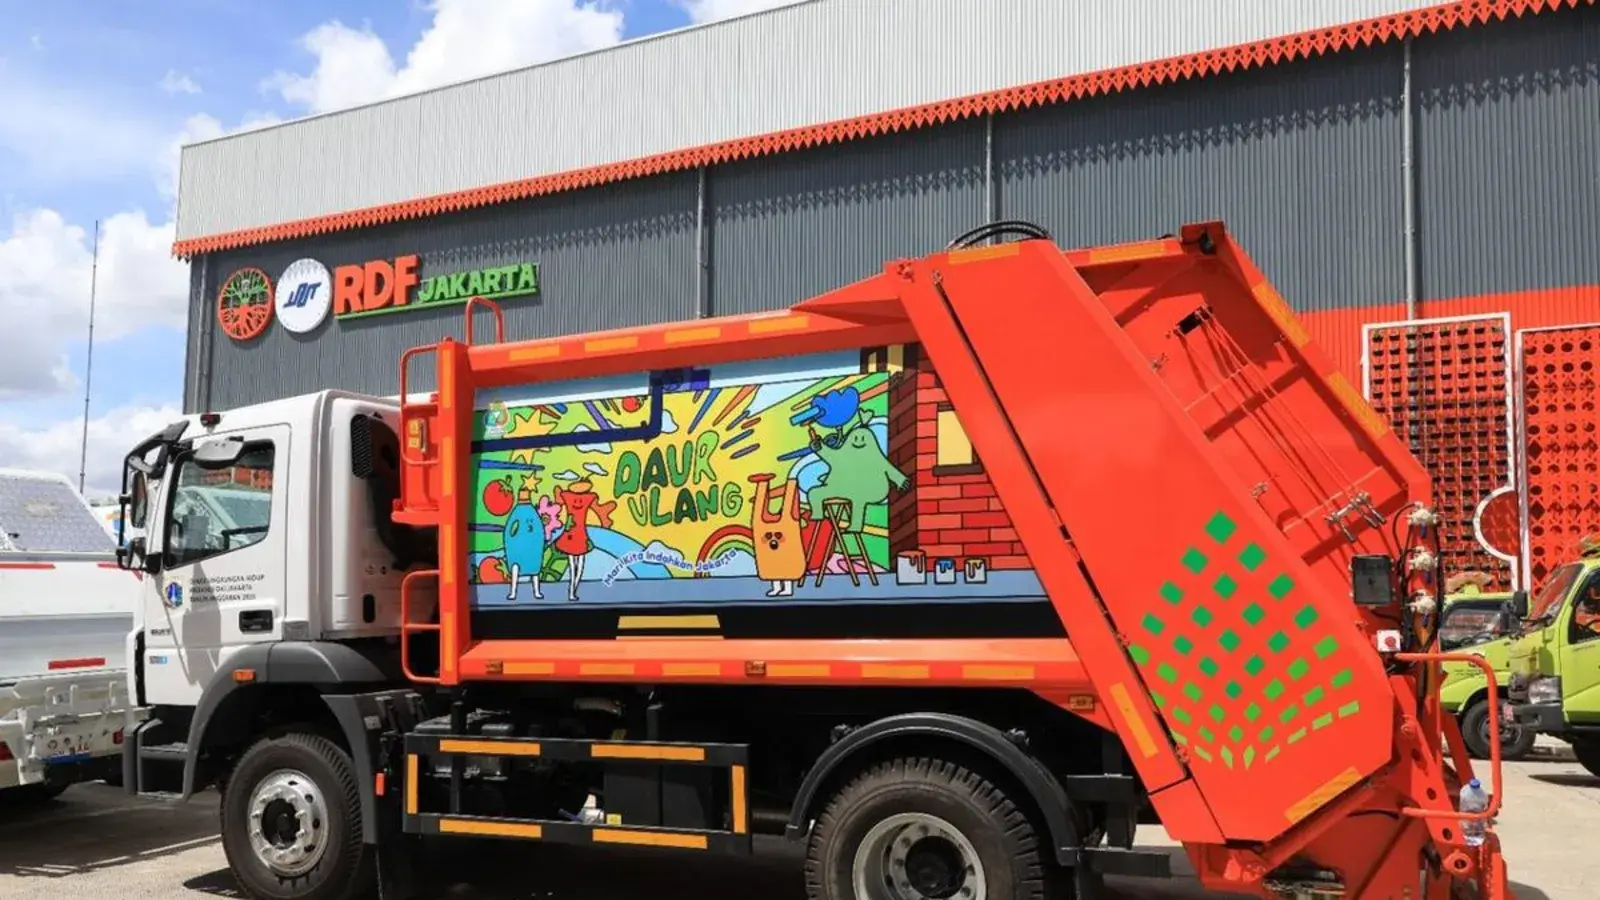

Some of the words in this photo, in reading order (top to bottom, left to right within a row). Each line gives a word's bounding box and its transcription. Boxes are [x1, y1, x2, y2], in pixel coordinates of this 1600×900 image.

[333, 254, 420, 315] RDF
[419, 263, 537, 301] JAKARTA
[613, 430, 720, 499] DAUR
[627, 481, 743, 526] ULANG
[645, 551, 693, 571] Indahkan
[695, 549, 737, 571] Jakarta
